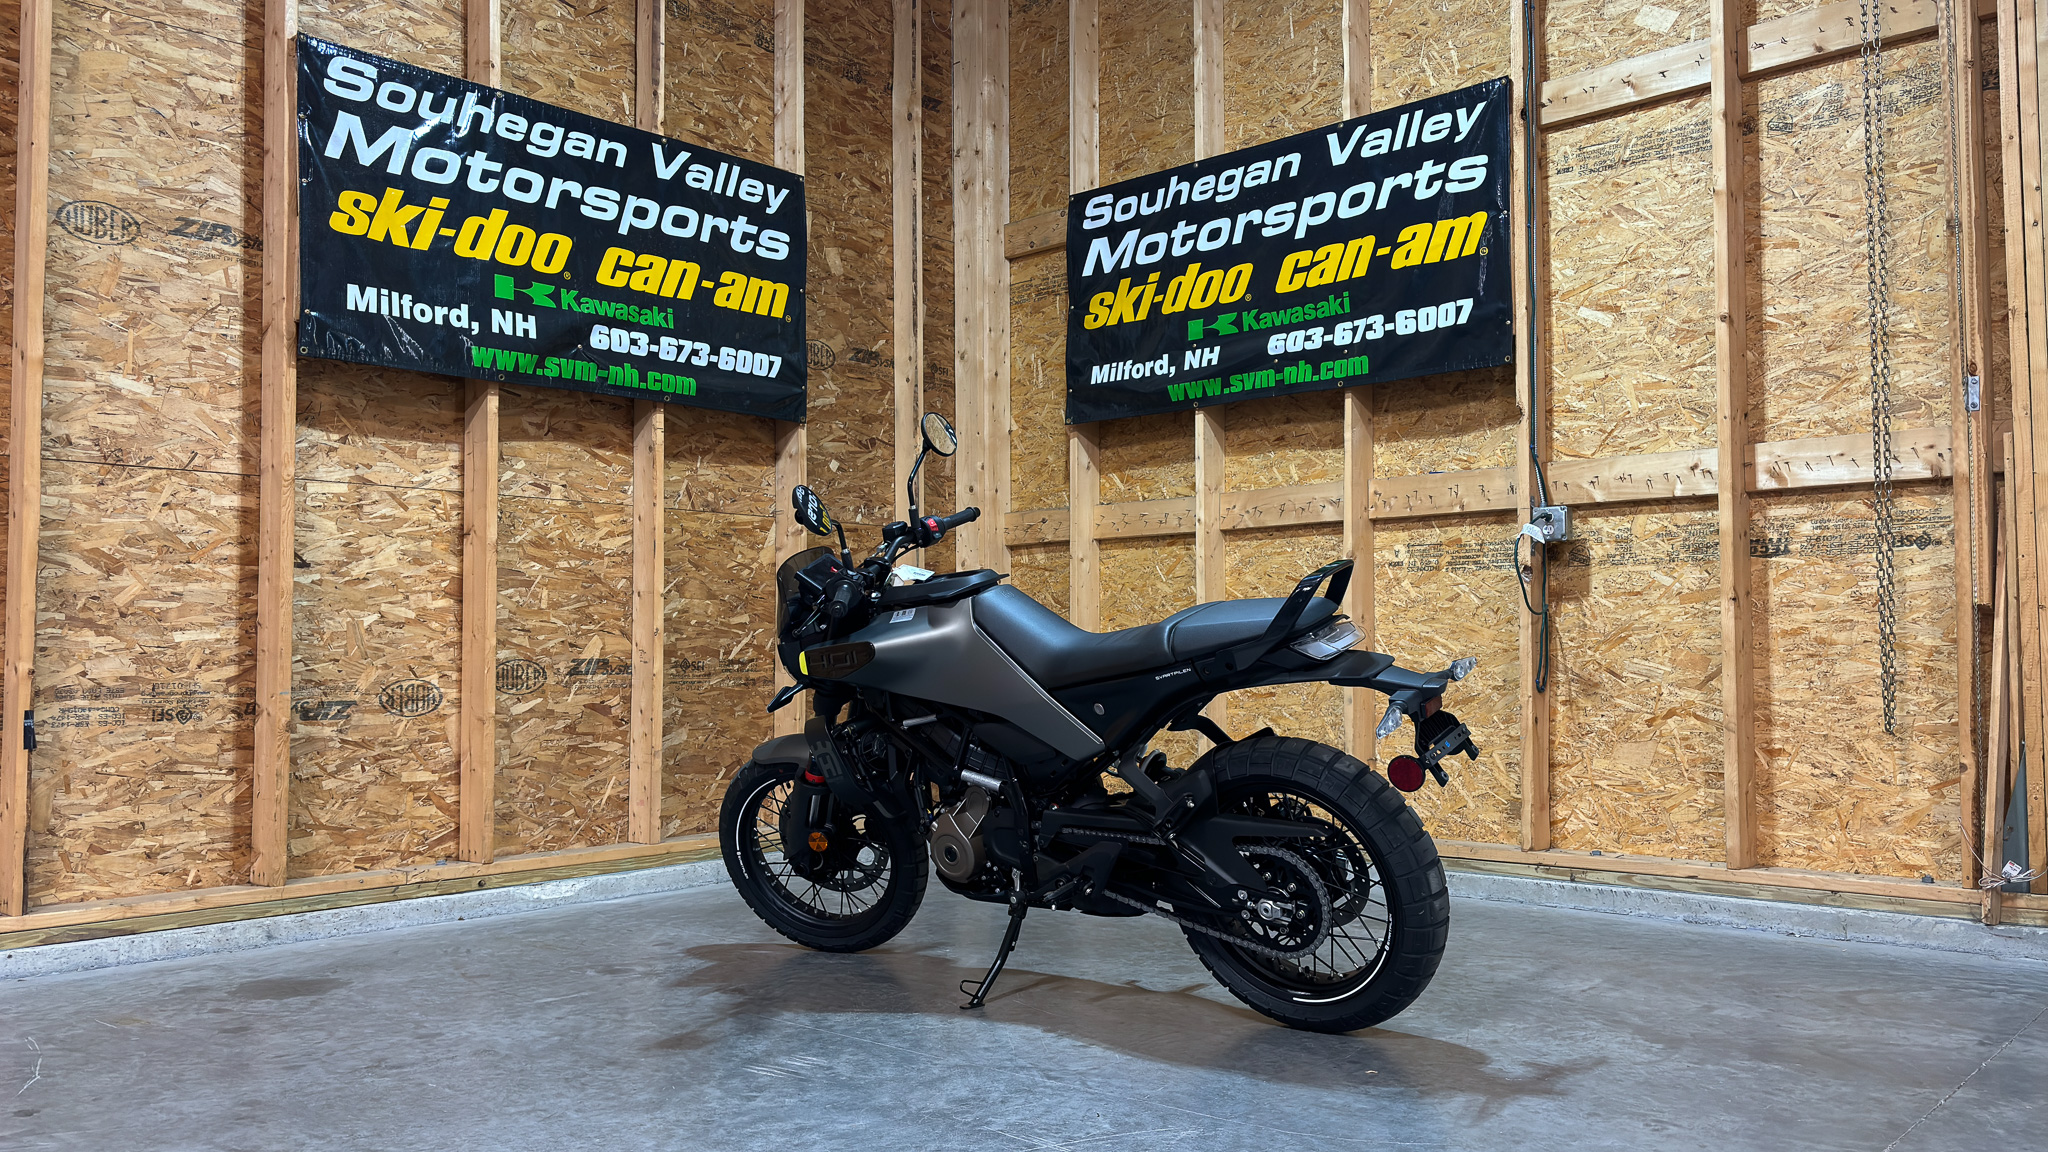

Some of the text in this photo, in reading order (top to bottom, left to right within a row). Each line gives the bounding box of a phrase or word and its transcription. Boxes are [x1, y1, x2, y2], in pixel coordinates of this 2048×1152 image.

[323, 55, 790, 215] Souhegan Valley
[324, 110, 791, 261] Motorsports
[1082, 102, 1486, 230] Souhegan Valley
[1082, 154, 1489, 277] Motorsports
[328, 187, 790, 319] ski-doo can-am
[1083, 261, 1254, 330] ski-doo
[1275, 210, 1488, 294] can-am
[346, 284, 537, 339] Milford, NH
[560, 288, 674, 330] Kawasaki
[1243, 291, 1350, 331] Kawasaki
[1267, 297, 1474, 355] 603-673-6007
[471, 345, 697, 397] www.svm-nh.com
[589, 324, 782, 379] 603-673-6007
[1090, 346, 1220, 385] Milford, NH
[1167, 353, 1369, 402] www.svm-nh.com
[152, 708, 176, 722] SFI
